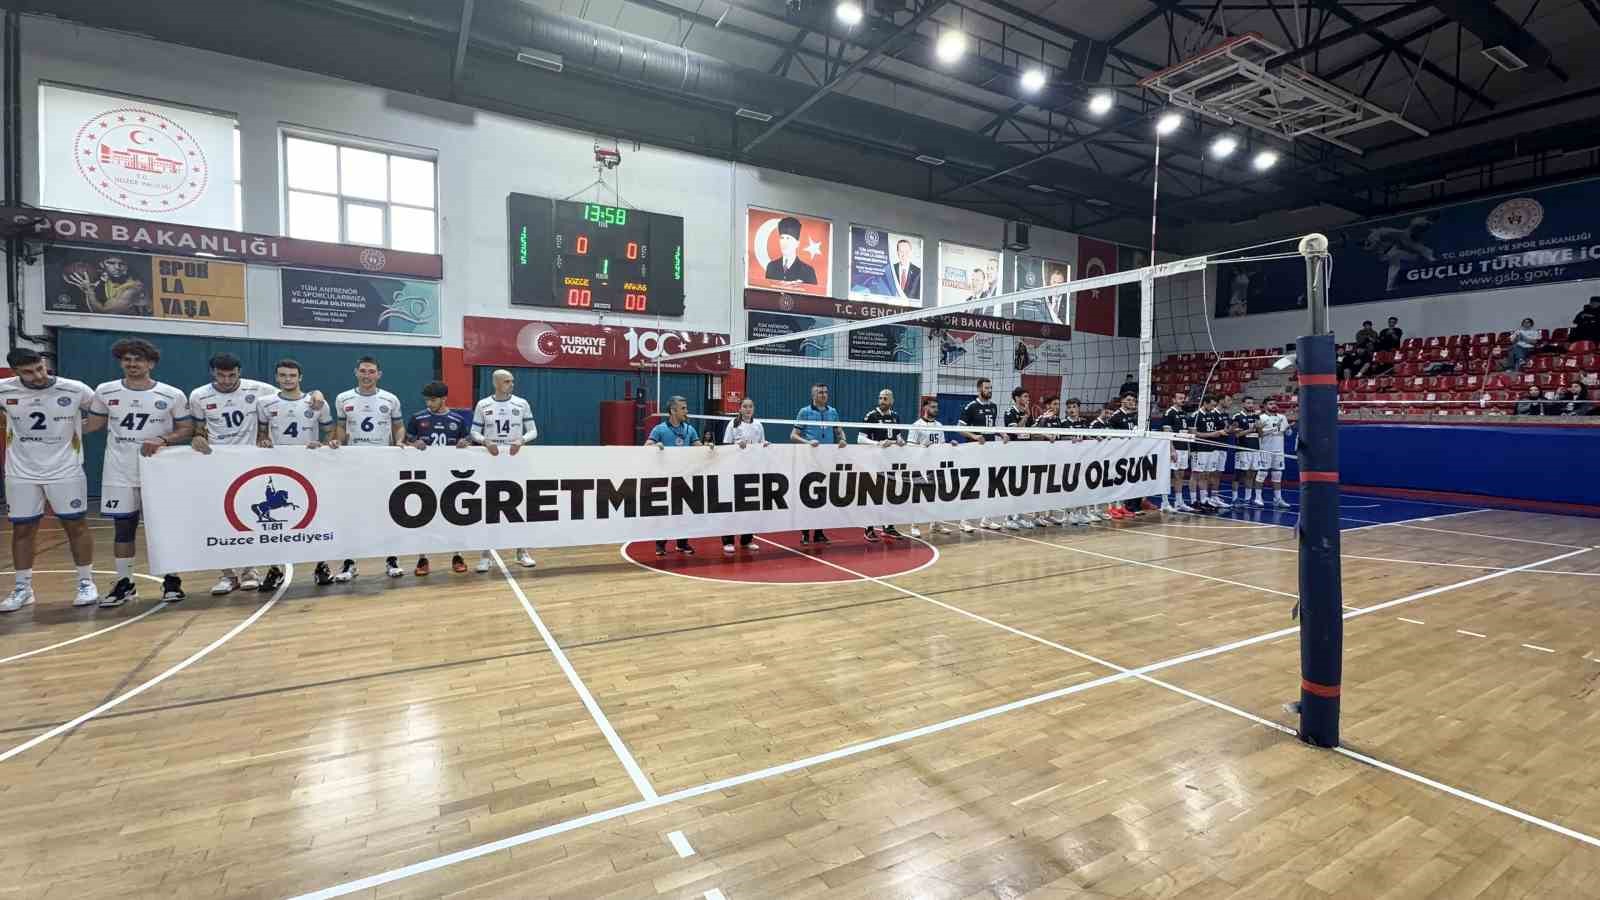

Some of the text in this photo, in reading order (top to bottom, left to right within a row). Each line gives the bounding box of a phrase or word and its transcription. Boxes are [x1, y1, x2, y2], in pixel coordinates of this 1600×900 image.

[584, 204, 626, 225] 13:58
[112, 224, 278, 257] BAKANLIĞI
[577, 236, 588, 254] 0
[627, 242, 637, 260] 0
[159, 260, 209, 279] SPOR
[602, 259, 608, 274] 1
[1406, 262, 1473, 281] GÜÇLÜ
[161, 277, 185, 294] LA
[1459, 266, 1567, 287] www.gsb.gov.tr
[568, 289, 591, 306] 00
[625, 294, 647, 311] 00
[160, 298, 210, 318] YAŞA
[835, 303, 857, 315] T.C.
[961, 319, 1015, 332] BAKANLIĞI
[30, 411, 46, 430] 2
[120, 413, 151, 430] 47
[222, 410, 244, 428] 10
[361, 416, 374, 432] 6
[495, 419, 510, 434] 14
[283, 422, 298, 438] 4
[388, 454, 1157, 529] ÖĞRETMENLER GÜNÜNÜZ KUTLU OLSUN
[105, 500, 119, 509] 47
[259, 531, 334, 544] Belediyesi
